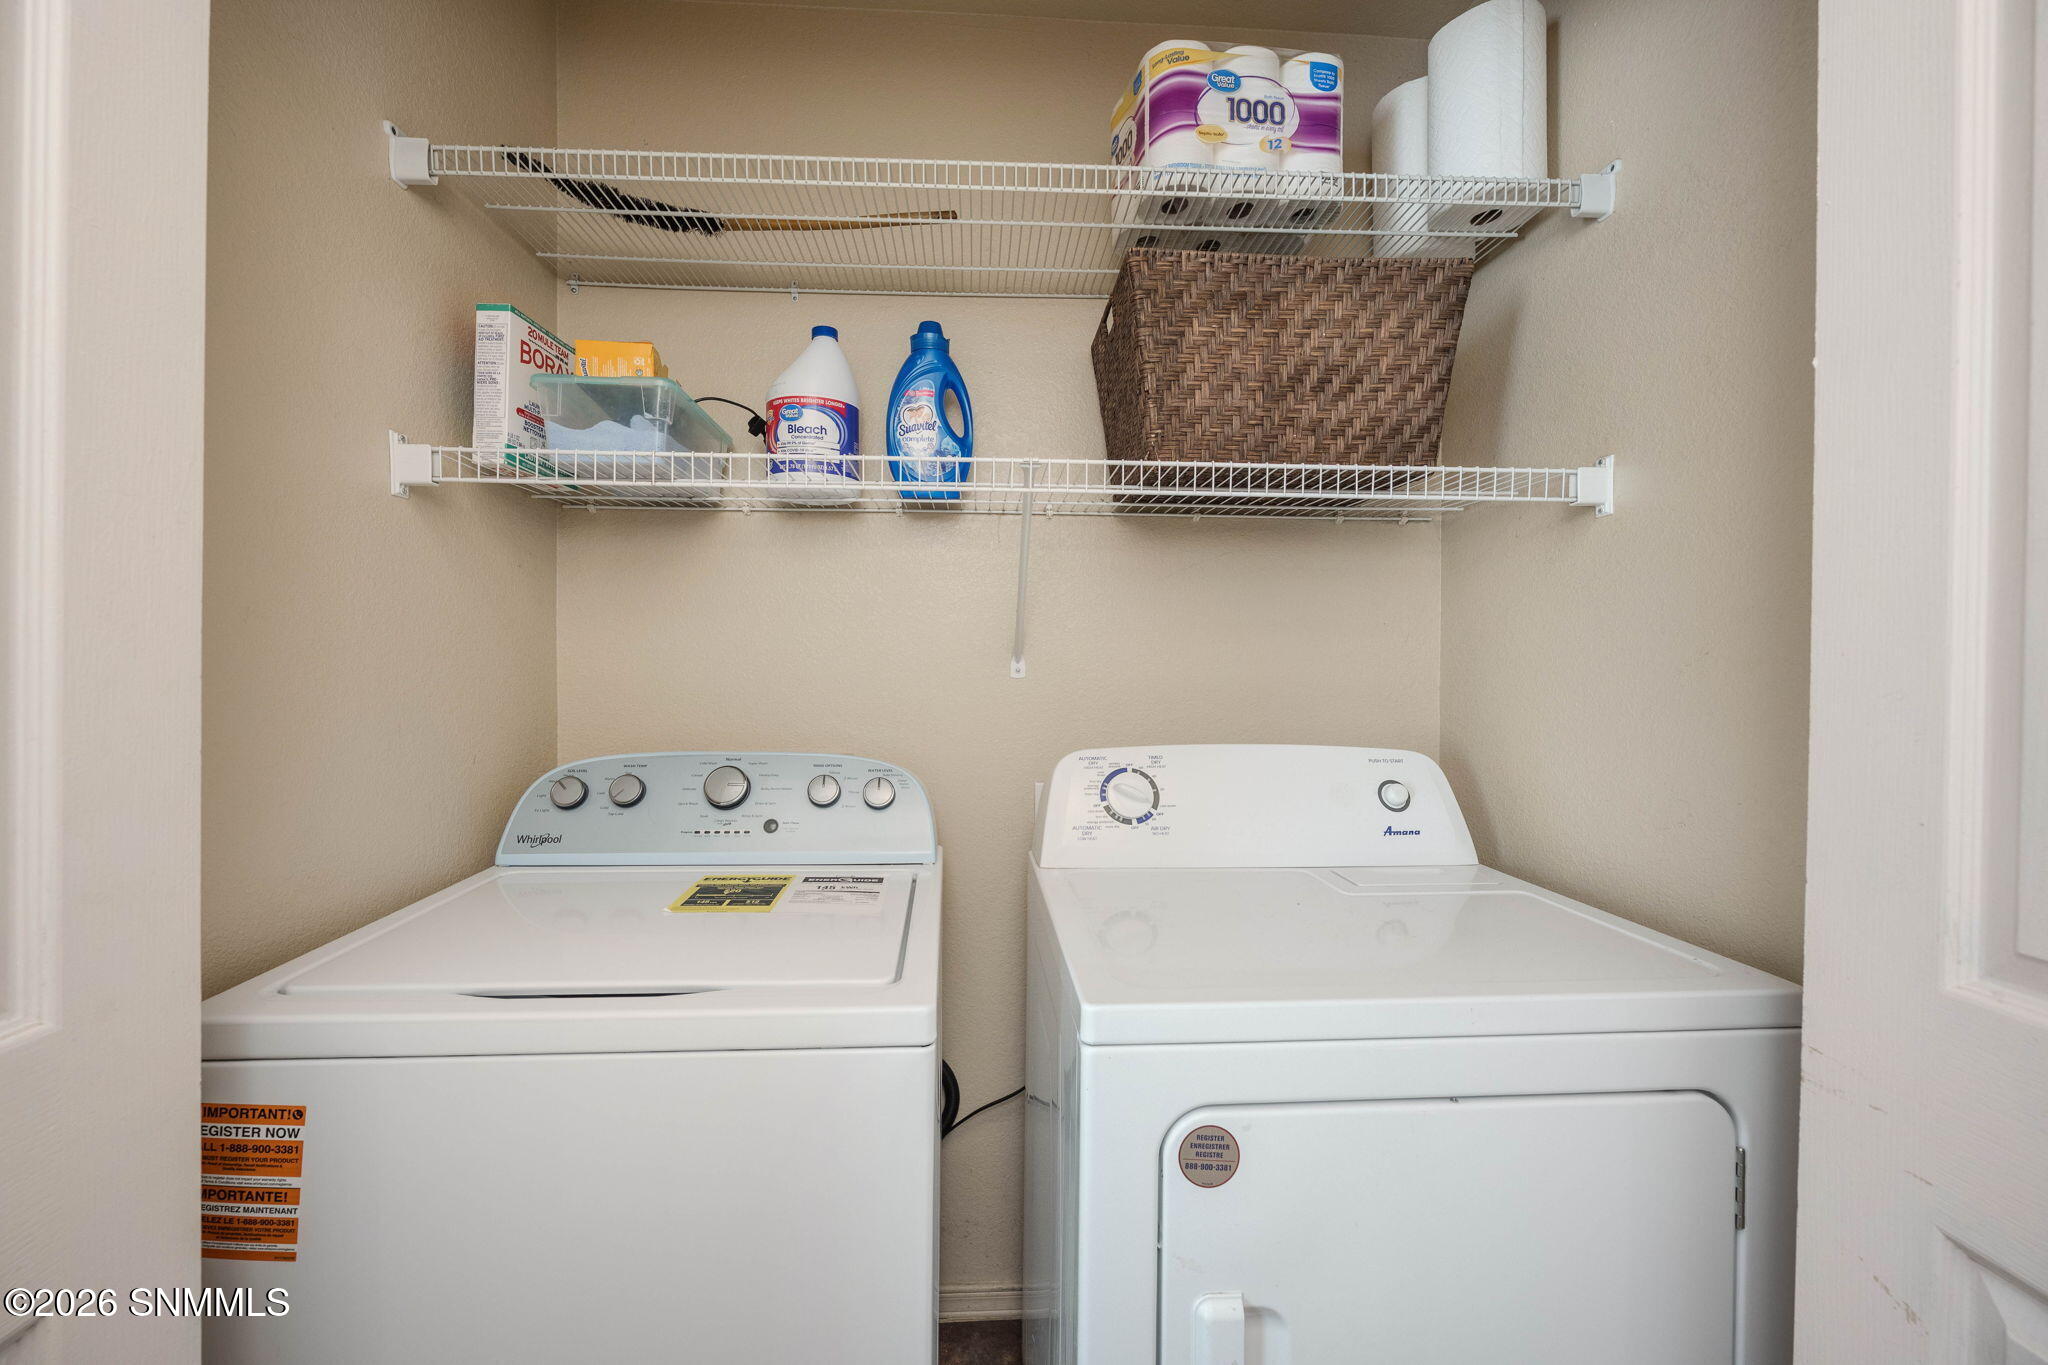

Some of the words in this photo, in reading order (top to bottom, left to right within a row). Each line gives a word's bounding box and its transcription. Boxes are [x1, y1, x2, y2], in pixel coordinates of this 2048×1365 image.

[1166, 55, 1190, 65] Value
[1211, 73, 1235, 84] Great
[1226, 97, 1286, 126] 1000
[1266, 138, 1282, 150] 12
[528, 326, 537, 340] 20
[538, 332, 554, 350] MULE
[554, 344, 568, 359] TEAM
[524, 420, 544, 432] BOOSTER
[788, 424, 827, 435] Bleach
[898, 420, 937, 436] Suavitel
[902, 434, 934, 443] complete
[1384, 826, 1420, 836] Amana
[517, 833, 562, 848] Whirlpool
[203, 1107, 291, 1120] IMPORTANT!
[201, 1126, 261, 1138] EGISTER
[265, 1128, 300, 1138] NOW
[1196, 1134, 1224, 1142] REGISTER
[220, 1144, 299, 1154] 1-888-900-3381
[1190, 1142, 1230, 1150] ENREGISTRER
[202, 1189, 288, 1202] MPORTANTE!
[201, 1204, 240, 1213] EGISTREZ
[243, 1206, 298, 1215] MAINTENANT
[237, 1218, 294, 1226] 1-888-900-3381
